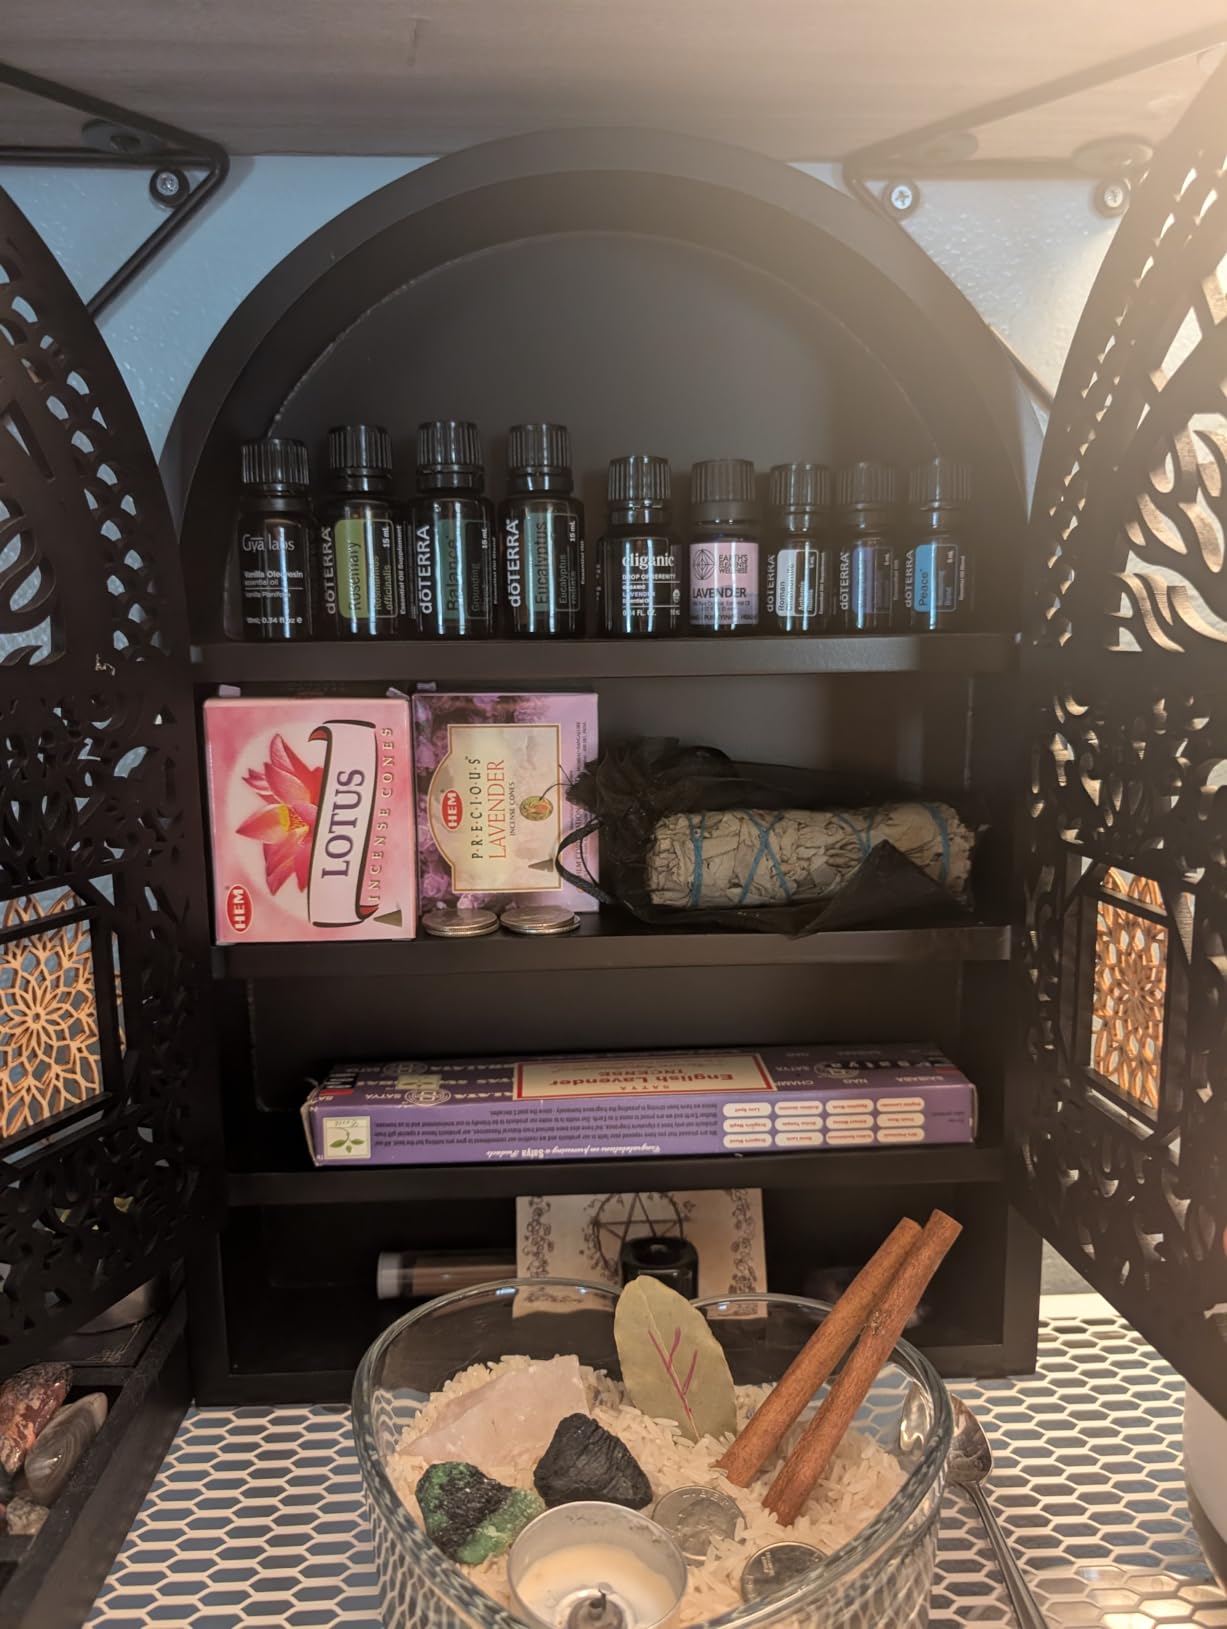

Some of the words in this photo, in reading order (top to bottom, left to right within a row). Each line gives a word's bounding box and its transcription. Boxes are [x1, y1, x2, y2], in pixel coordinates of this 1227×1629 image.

[570, 532, 576, 542] 15
[266, 570, 304, 578] Oleoesin
[350, 542, 362, 611] Rosemary
[535, 522, 548, 605] Eucalyptus
[692, 588, 746, 598] LAVENDER
[919, 572, 928, 606] Peace
[321, 768, 365, 879] LOTUS
[368, 808, 392, 902] INCENSE
[381, 727, 394, 798] CONES
[447, 791, 458, 829] HEM
[487, 759, 508, 860] LAVENDER
[233, 887, 246, 930] HEM
[364, 1092, 401, 1100] SATYA
[549, 1076, 648, 1086] Lavender
[655, 1074, 734, 1084] English
[522, 1148, 544, 1159] Satya
